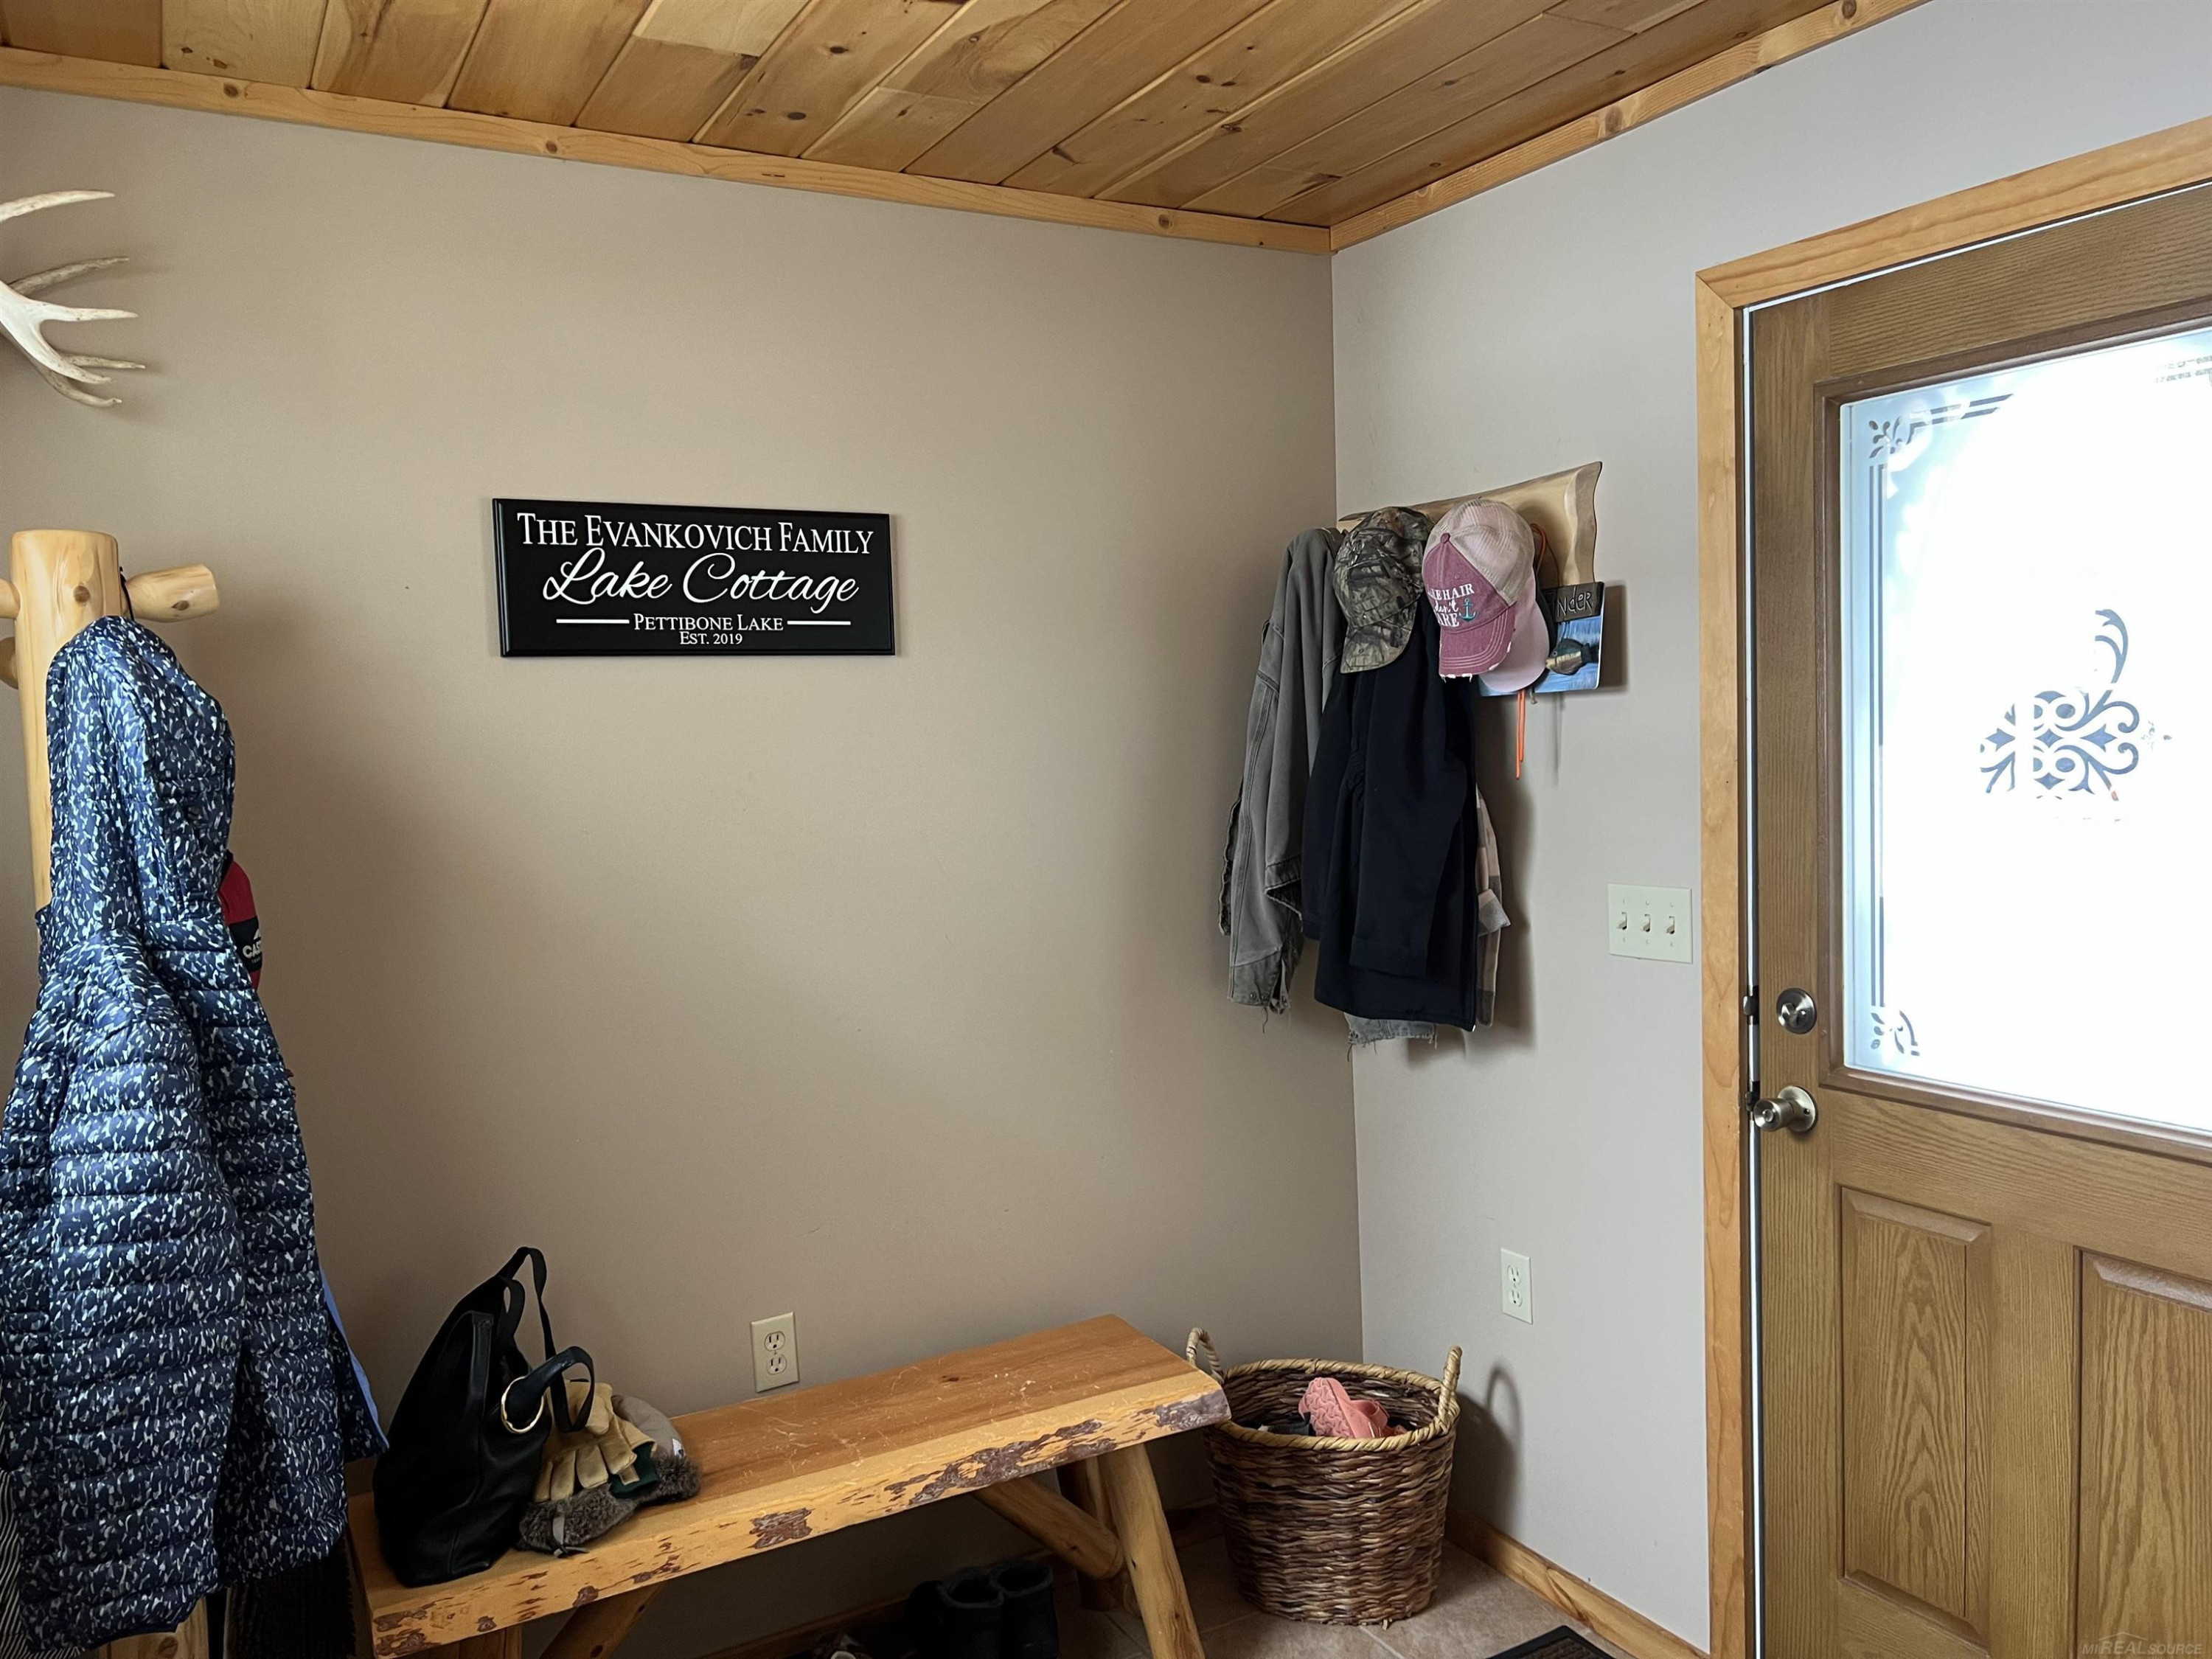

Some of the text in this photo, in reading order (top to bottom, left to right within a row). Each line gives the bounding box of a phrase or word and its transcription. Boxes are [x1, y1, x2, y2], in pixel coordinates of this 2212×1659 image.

[584, 515, 773, 552] EVANKOVICH
[778, 521, 874, 554] FAMILY
[542, 547, 860, 614] Lake Cottage
[633, 613, 784, 631] PETTIBONE LAKE
[1434, 609, 1460, 627] ARE
[679, 630, 743, 645] EST. 2019
[242, 940, 262, 959] CAS
